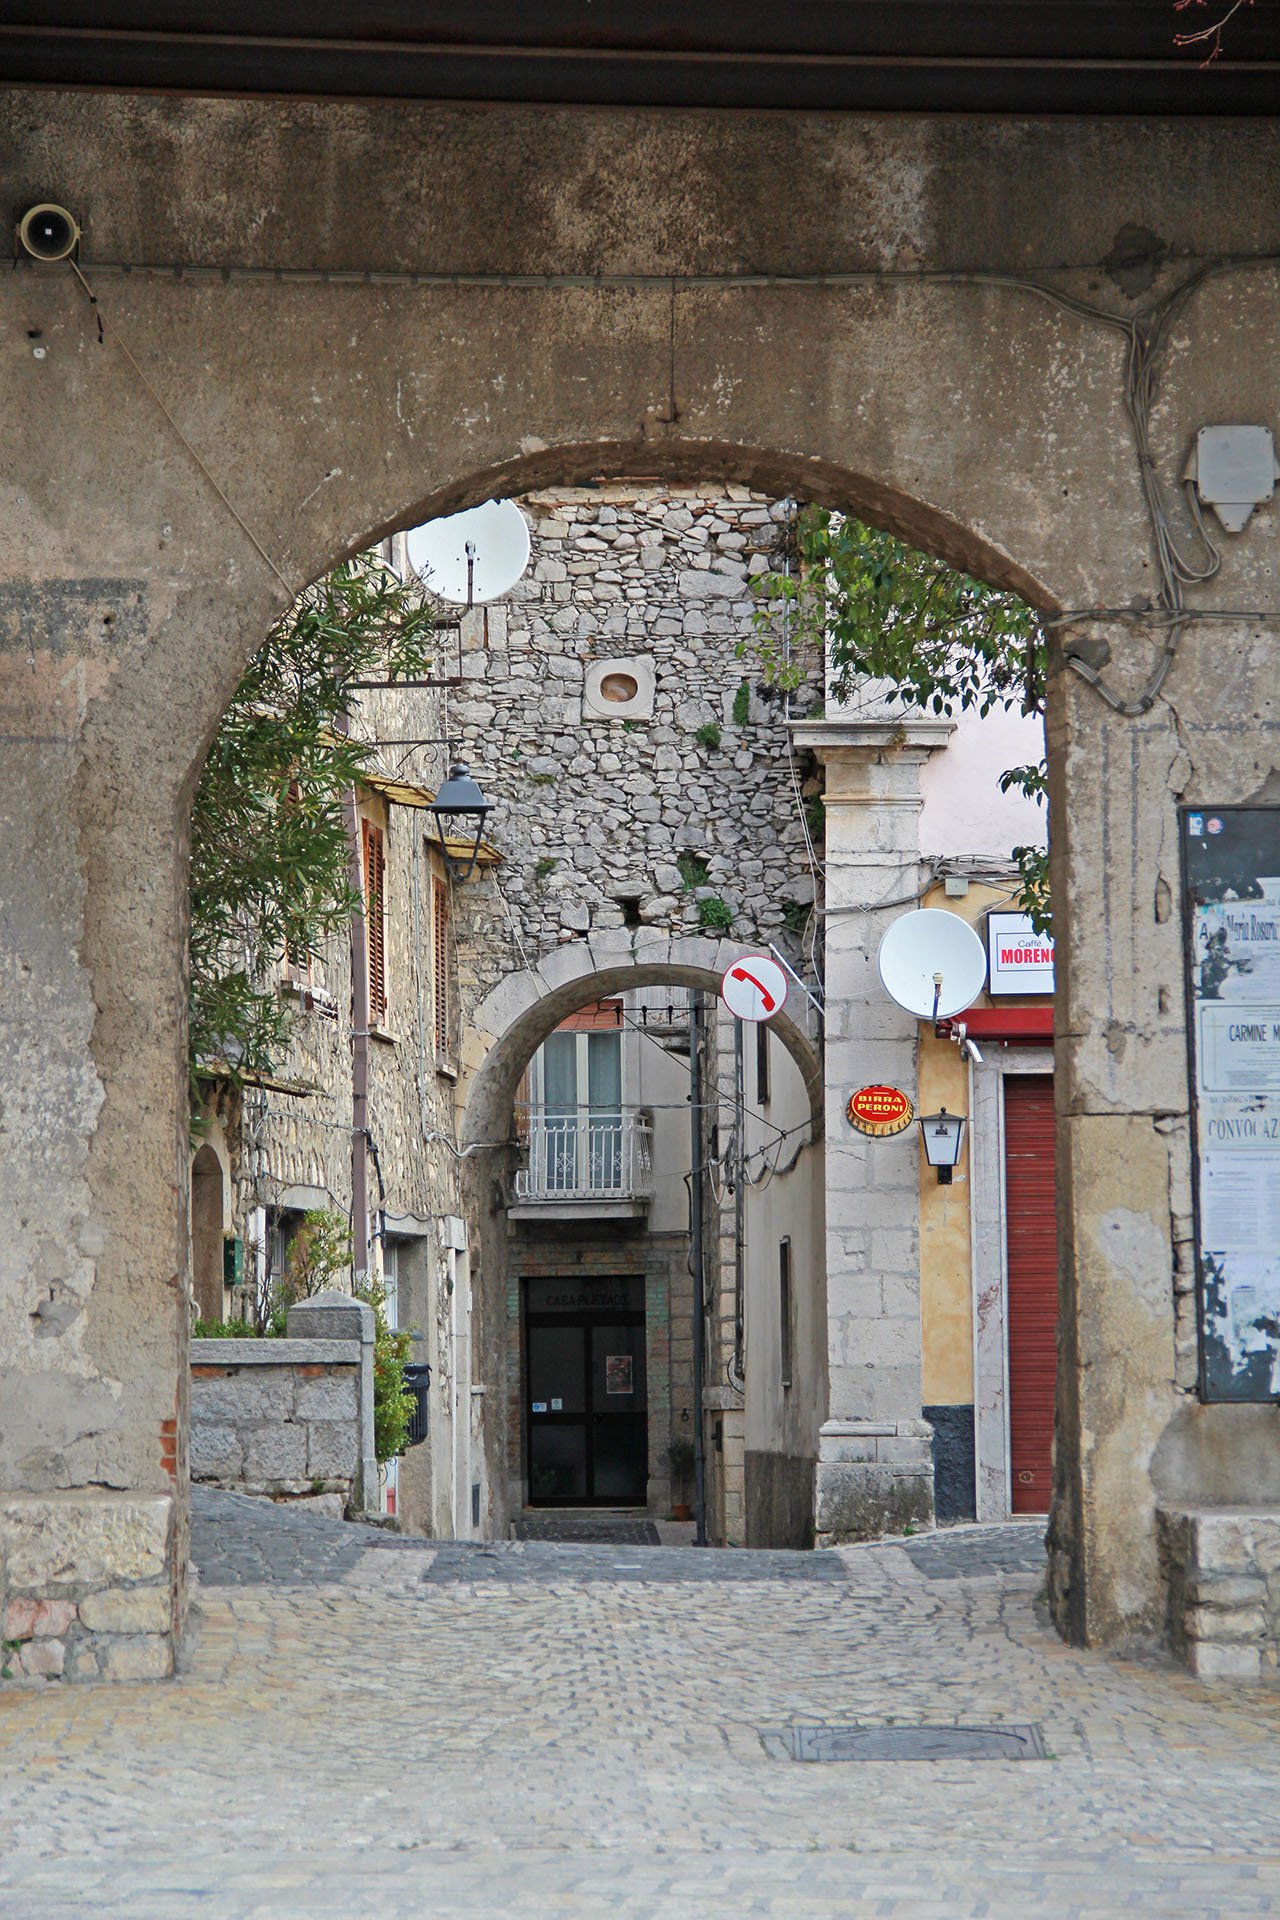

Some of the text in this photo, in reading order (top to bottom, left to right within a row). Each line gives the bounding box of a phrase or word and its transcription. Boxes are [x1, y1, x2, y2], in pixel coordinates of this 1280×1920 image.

[1229, 1024, 1267, 1042] CARMINE
[858, 1095, 902, 1103] BIRRA
[857, 1103, 903, 1112] PERONI
